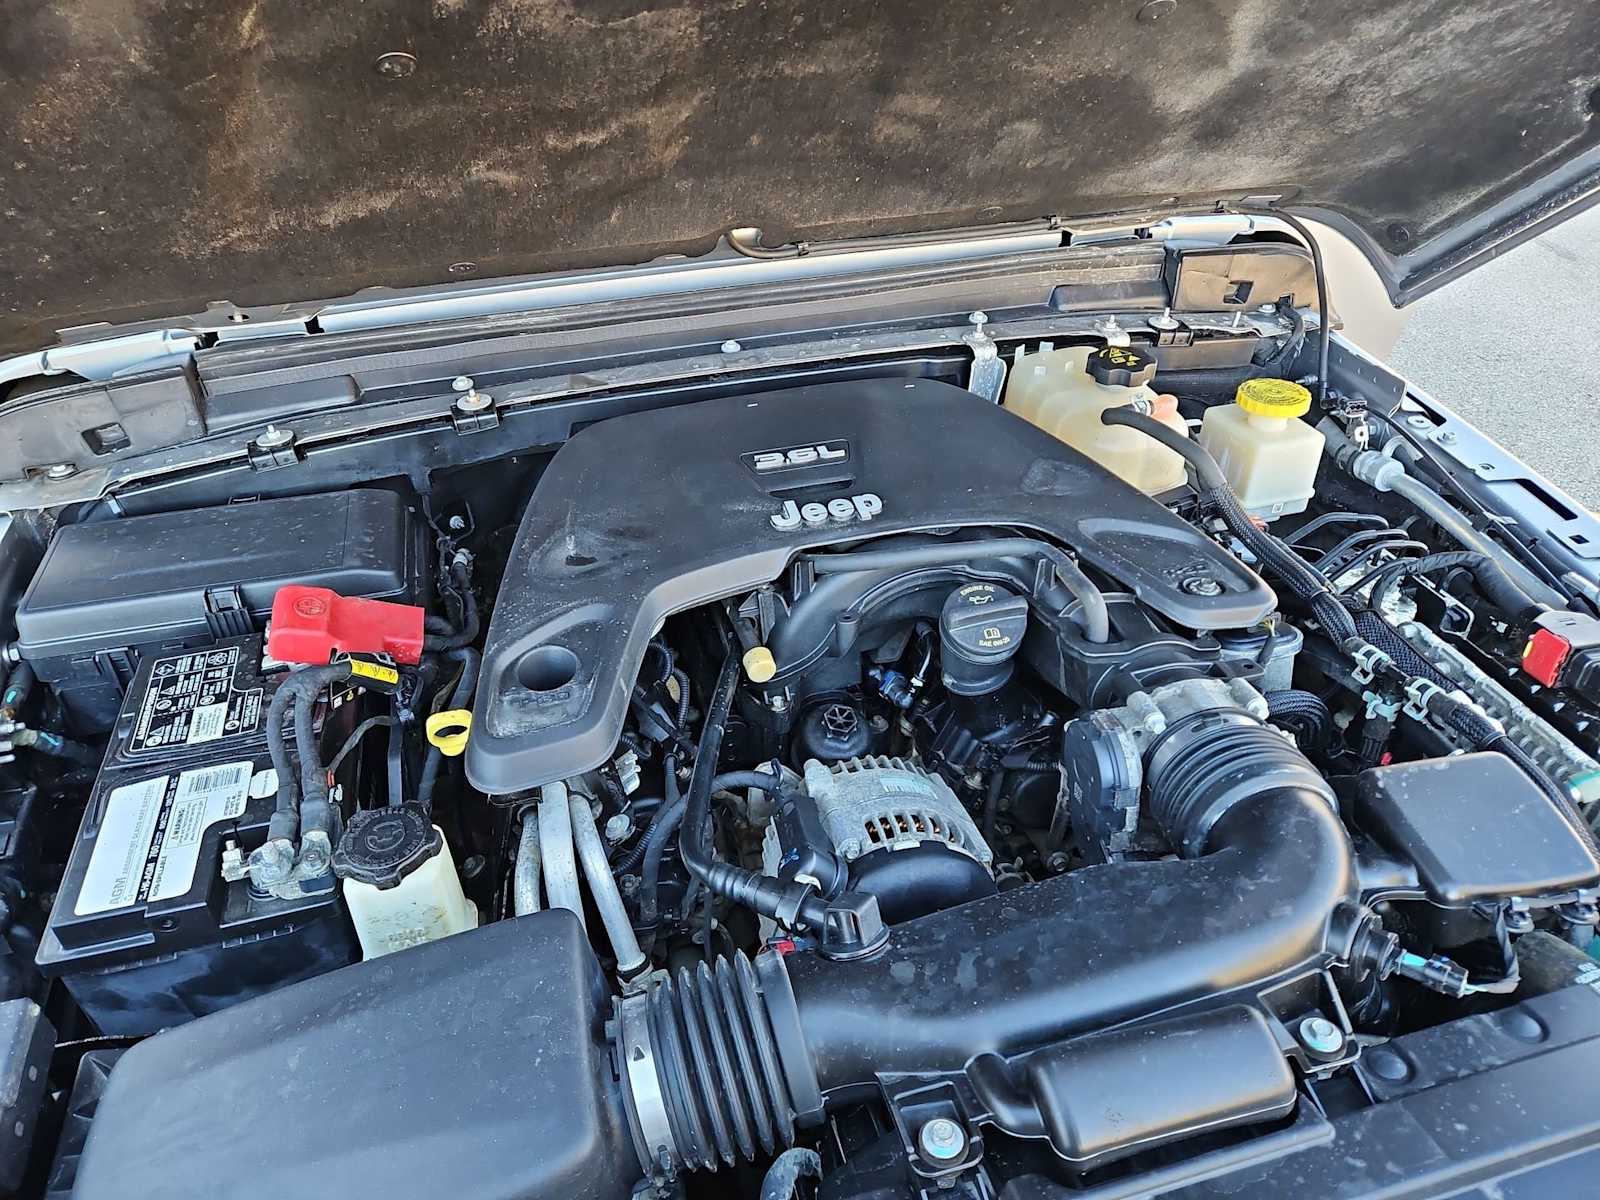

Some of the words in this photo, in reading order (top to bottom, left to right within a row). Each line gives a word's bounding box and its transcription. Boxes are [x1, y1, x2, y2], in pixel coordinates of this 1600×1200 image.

[769, 493, 883, 532] Jeep
[960, 584, 984, 596] ENGINE
[984, 584, 995, 593] OIL
[109, 877, 126, 905] AGM
